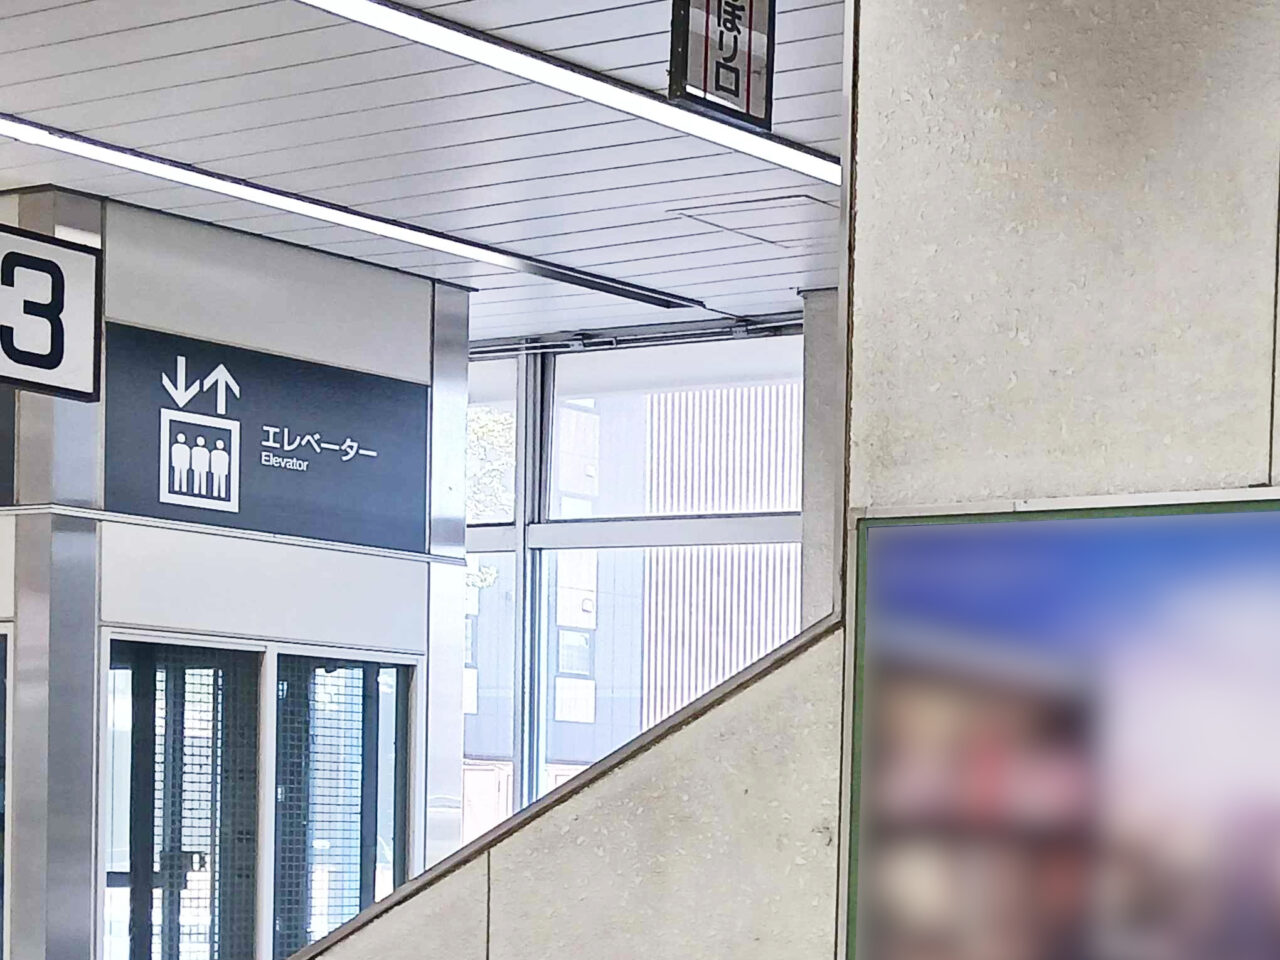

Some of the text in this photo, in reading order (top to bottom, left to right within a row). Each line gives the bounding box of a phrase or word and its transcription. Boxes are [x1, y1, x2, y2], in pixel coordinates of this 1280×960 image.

[715, 0, 746, 98] ぼり口
[0, 250, 65, 371] 3
[261, 425, 378, 461] エレベーター
[261, 451, 309, 471] Elevator
